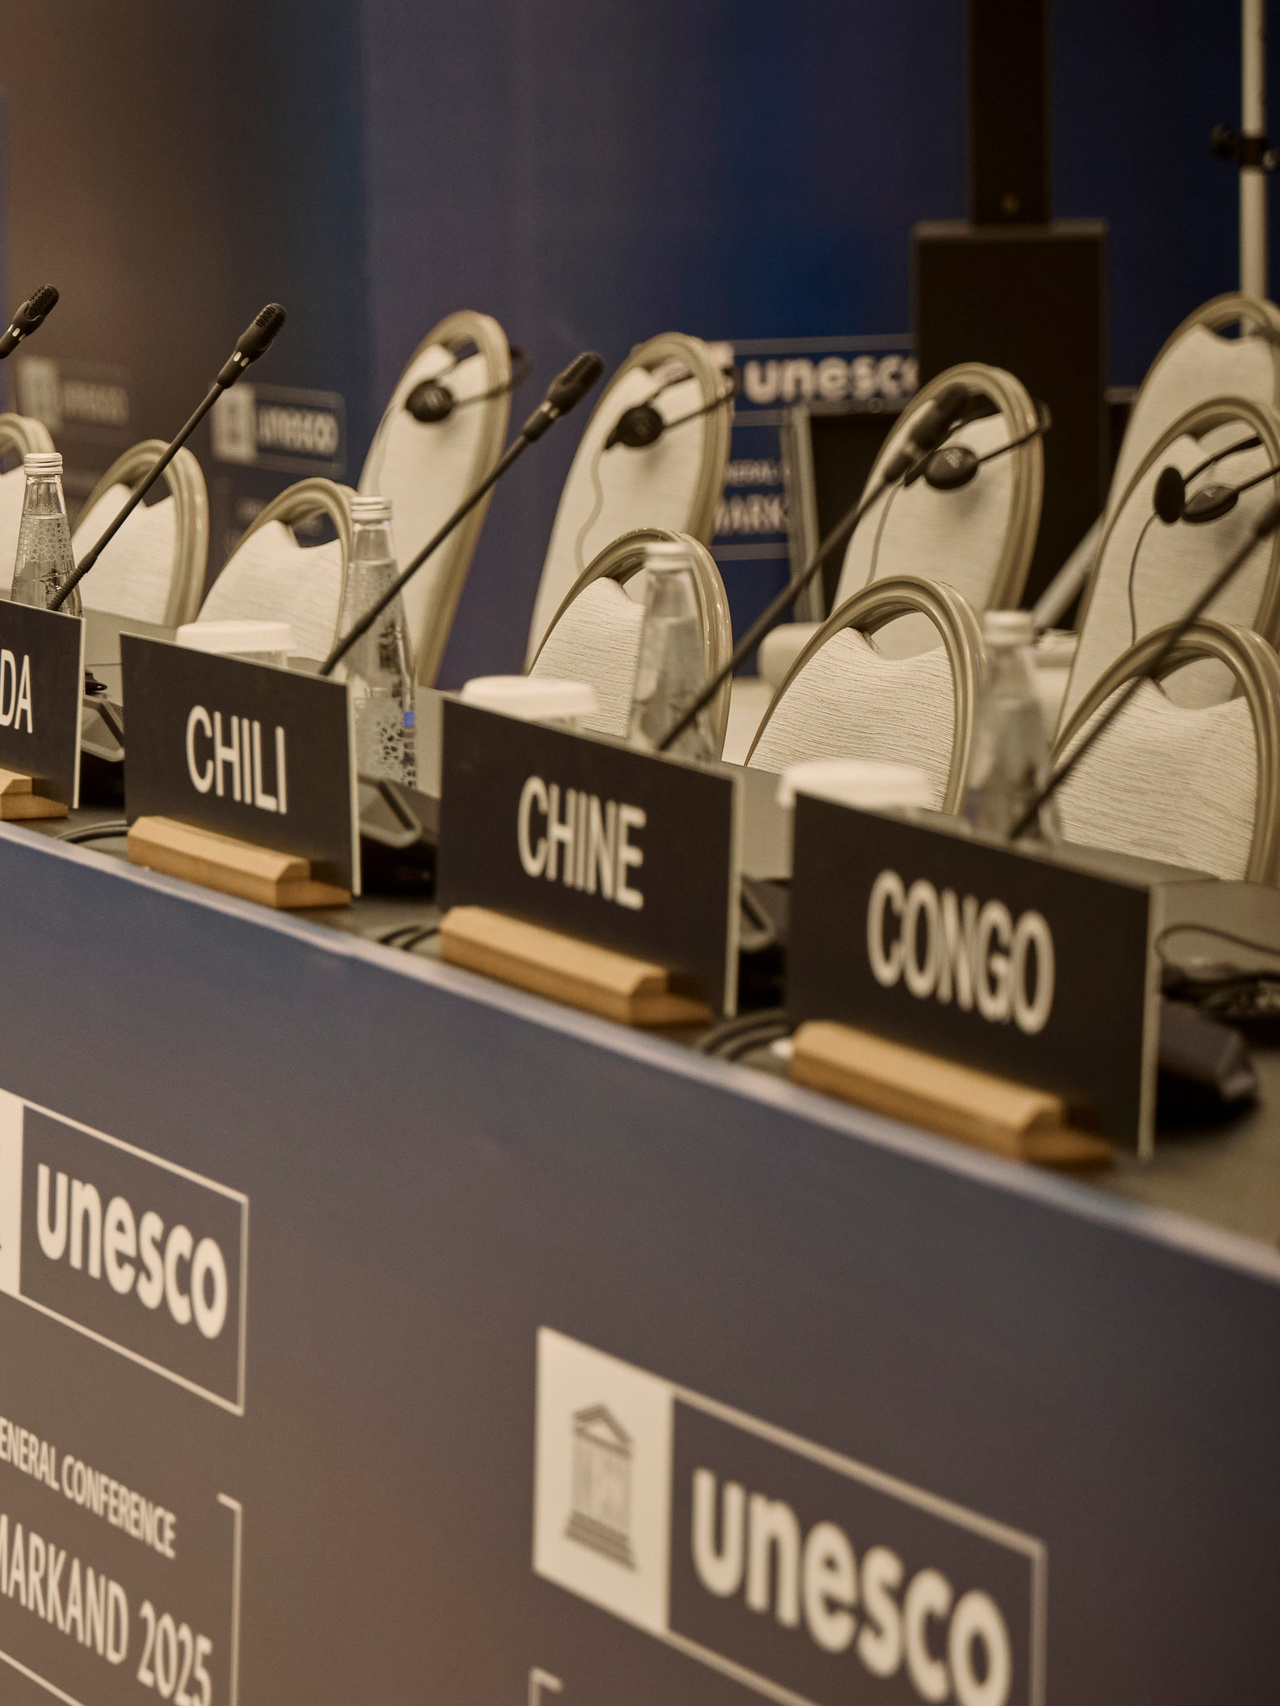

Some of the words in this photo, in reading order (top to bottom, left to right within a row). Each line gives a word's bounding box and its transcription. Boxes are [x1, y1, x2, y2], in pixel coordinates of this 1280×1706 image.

[186, 705, 287, 815] CHILI
[518, 775, 646, 910] CHINE
[866, 870, 1055, 1034] CONGO
[37, 1163, 228, 1339] unesco
[62, 1454, 176, 1559] CONFERENCE
[137, 1600, 213, 1706] 2025
[691, 1467, 1011, 1706] unesco
